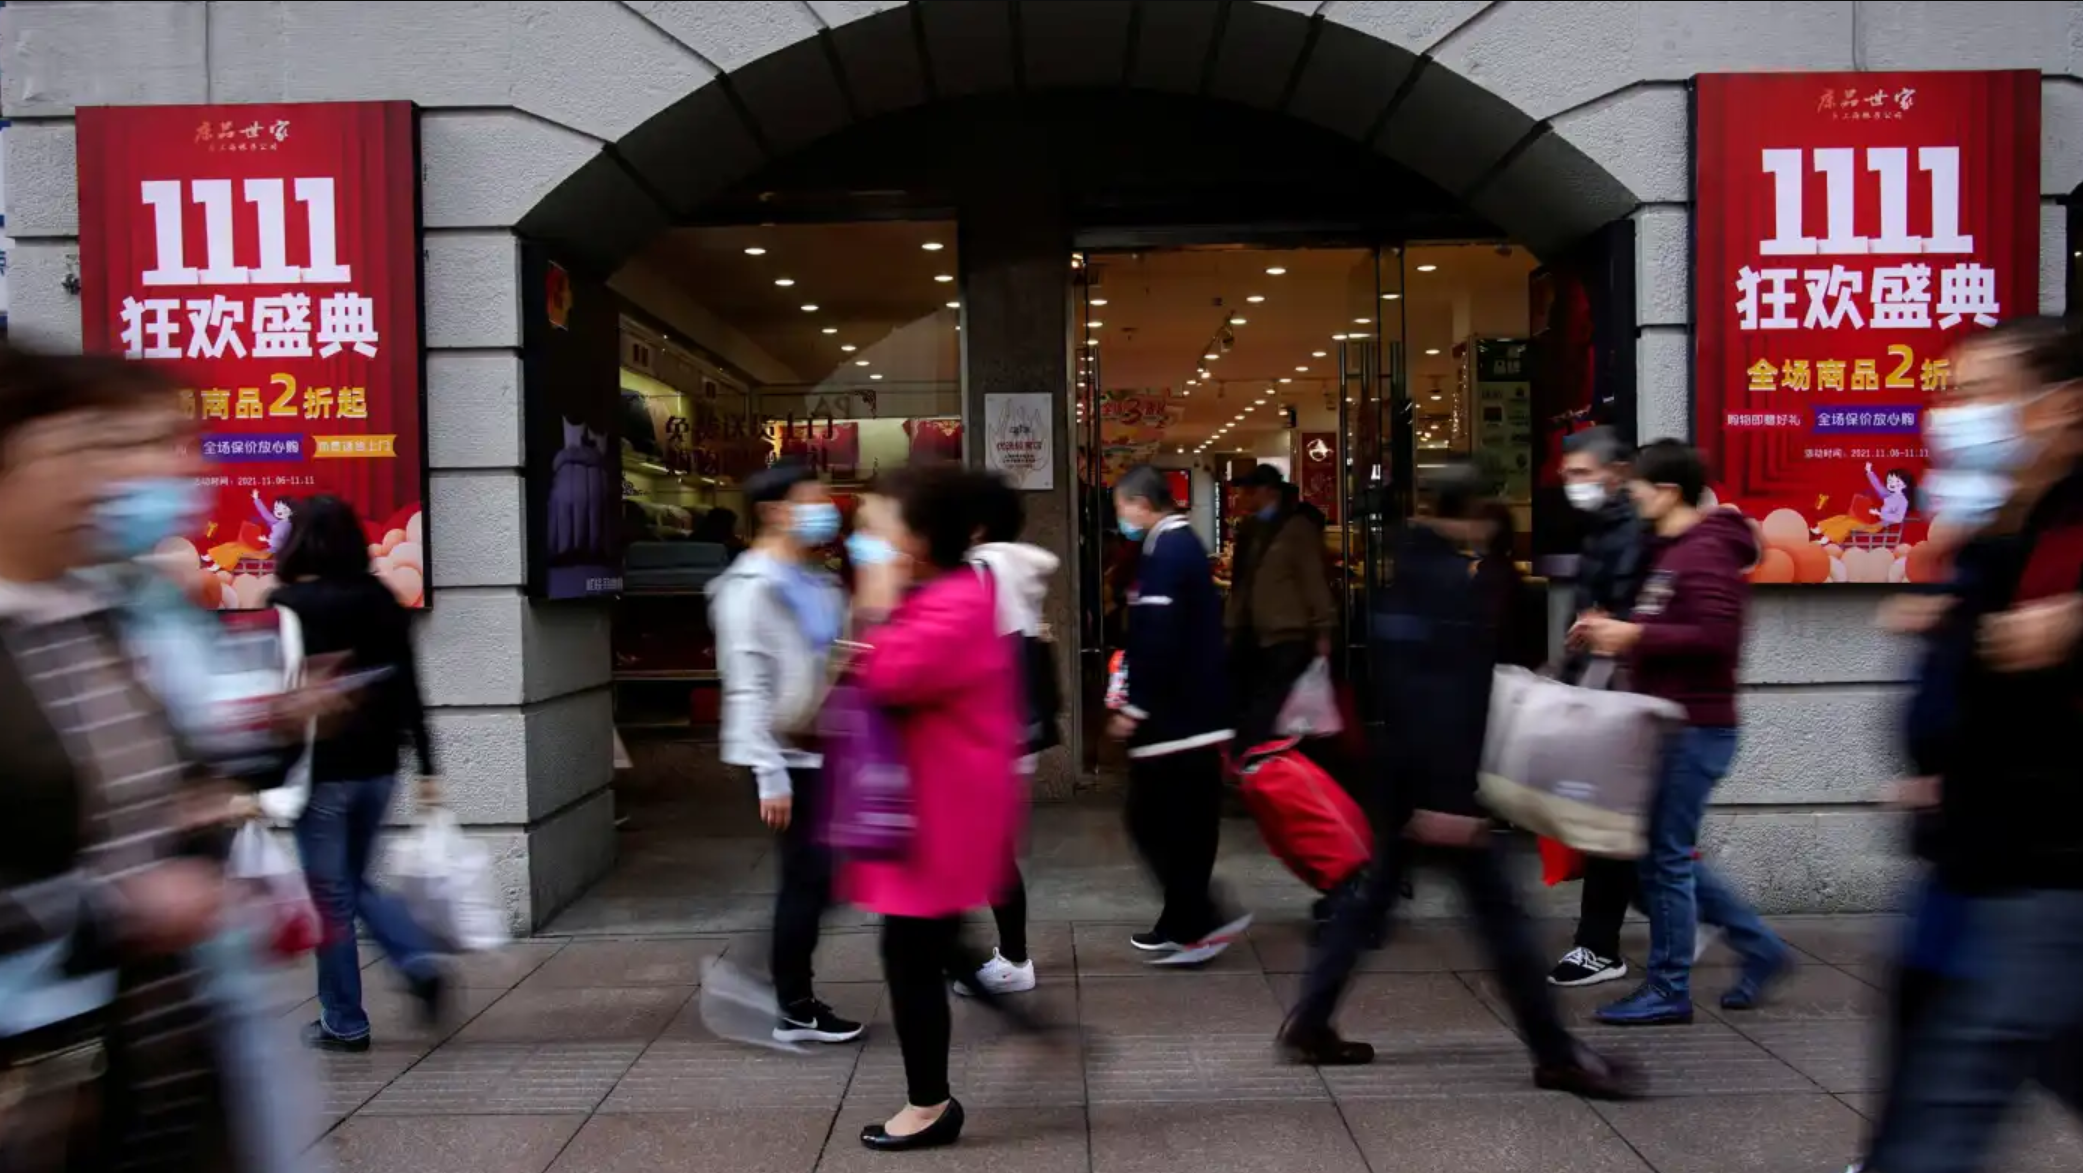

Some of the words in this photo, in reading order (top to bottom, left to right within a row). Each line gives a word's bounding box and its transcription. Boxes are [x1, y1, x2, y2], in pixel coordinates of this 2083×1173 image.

[140, 177, 352, 286] 1111
[1759, 146, 1974, 255] 1111
[120, 292, 379, 360] 狂欢盛典
[1735, 262, 2000, 330] 狂欢盛典
[203, 439, 300, 455] 全场保价放心购
[1817, 412, 1915, 427] 全场保价放心购
